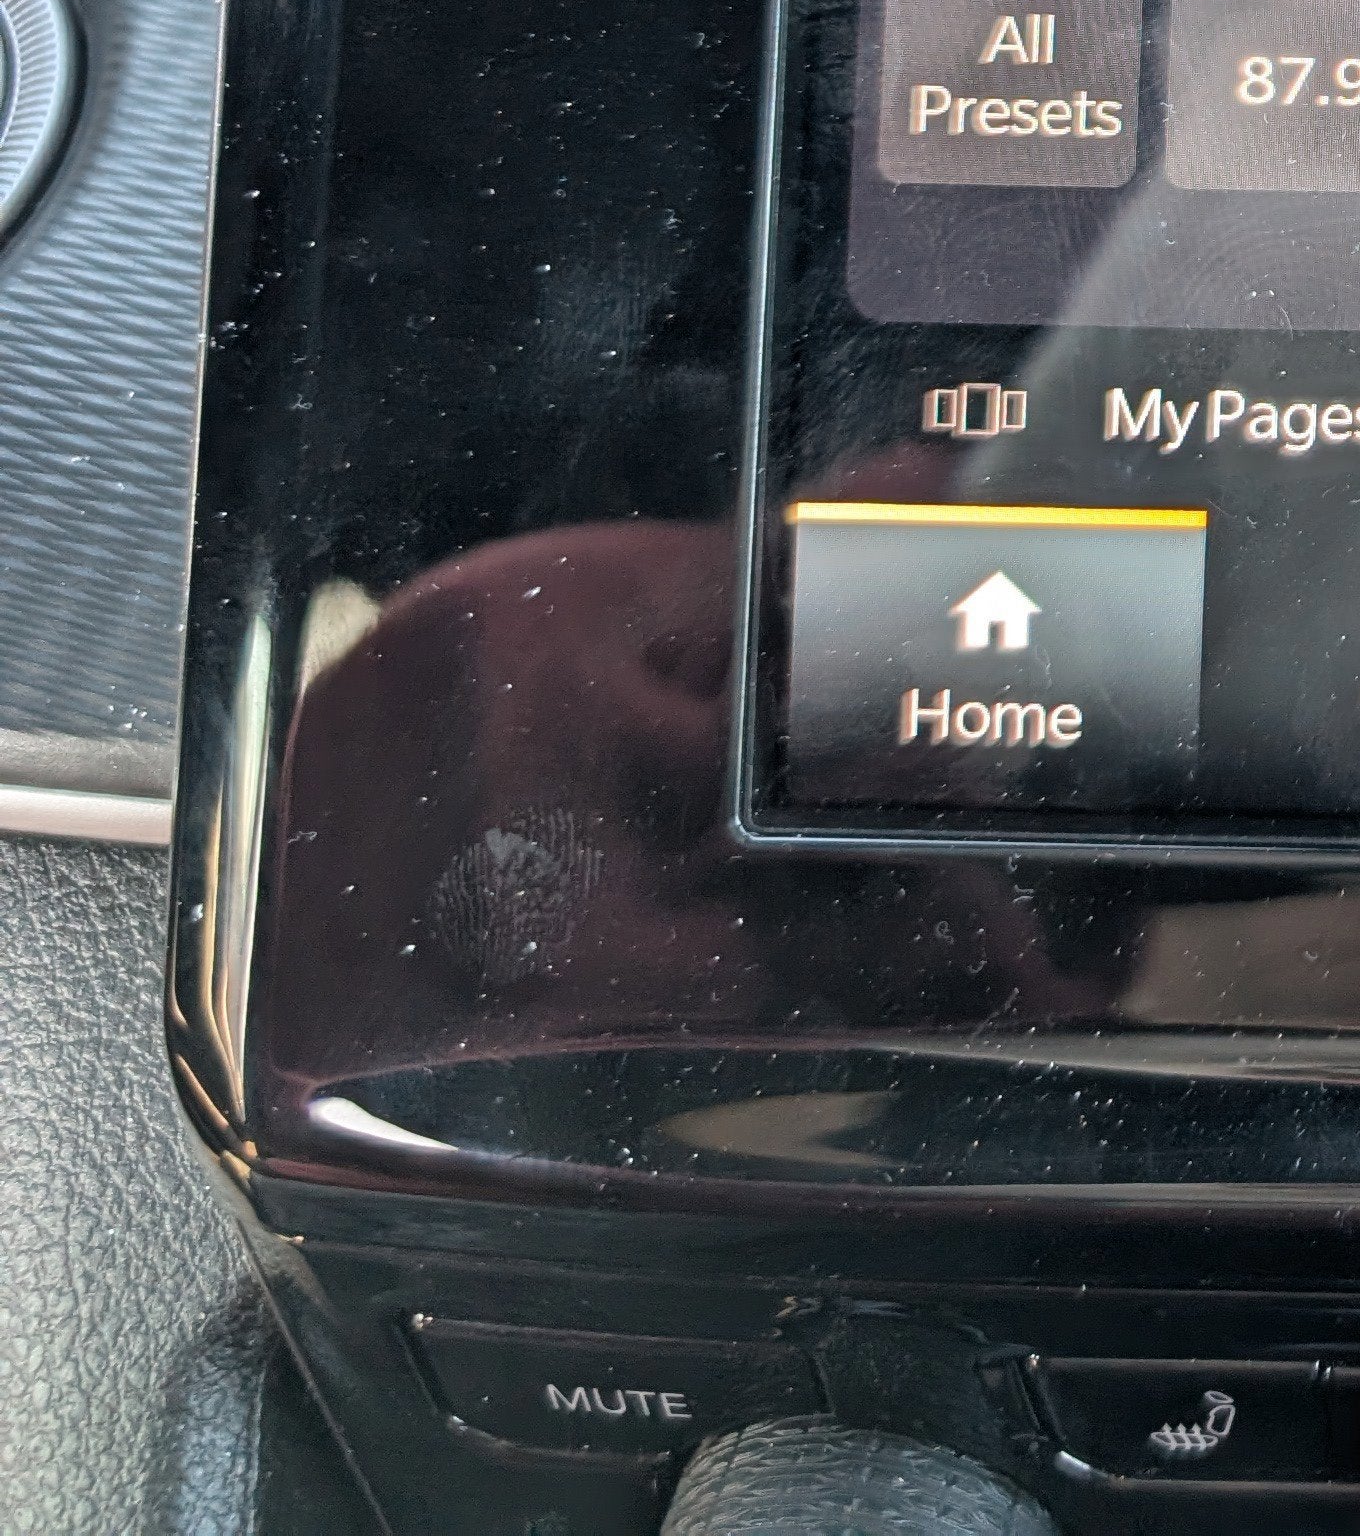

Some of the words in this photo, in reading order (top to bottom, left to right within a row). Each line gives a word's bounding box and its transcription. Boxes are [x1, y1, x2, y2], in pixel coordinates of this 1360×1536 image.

[979, 14, 1056, 65] All
[908, 84, 1124, 140] Presets
[897, 690, 1083, 747] Home
[546, 1383, 693, 1419] MUTE
